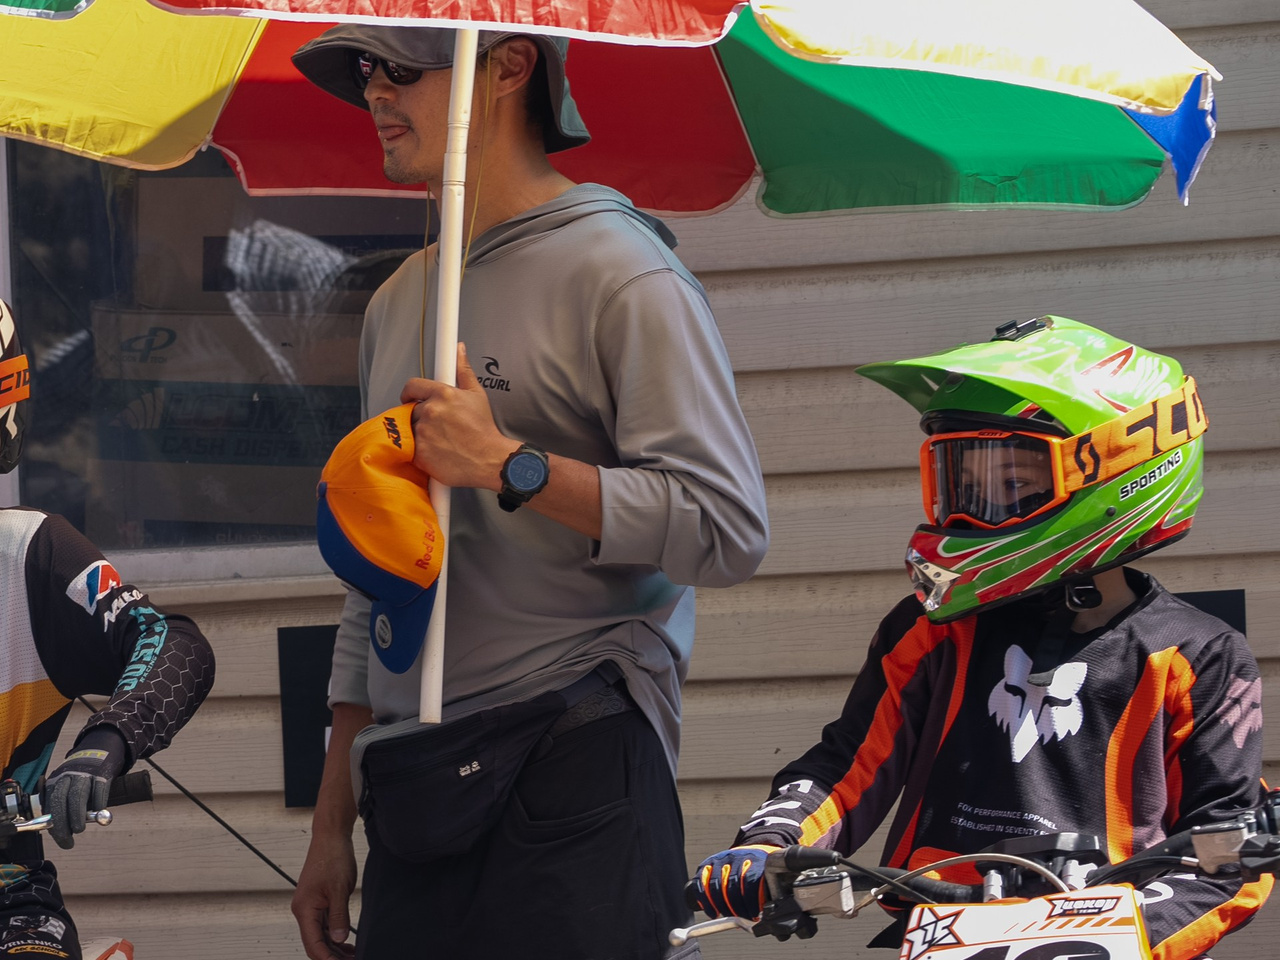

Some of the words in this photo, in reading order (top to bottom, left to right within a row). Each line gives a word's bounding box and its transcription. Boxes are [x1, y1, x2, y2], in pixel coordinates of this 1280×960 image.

[384, 416, 402, 449] KTM
[1106, 384, 1210, 462] SCO
[1119, 450, 1183, 501] SPORTING
[957, 802, 973, 813] FOX
[973, 808, 1022, 819] PERFORMANCE
[1022, 812, 1058, 830] APPAREL
[995, 824, 1004, 832] IN
[1004, 825, 1039, 836] SEVENTY
